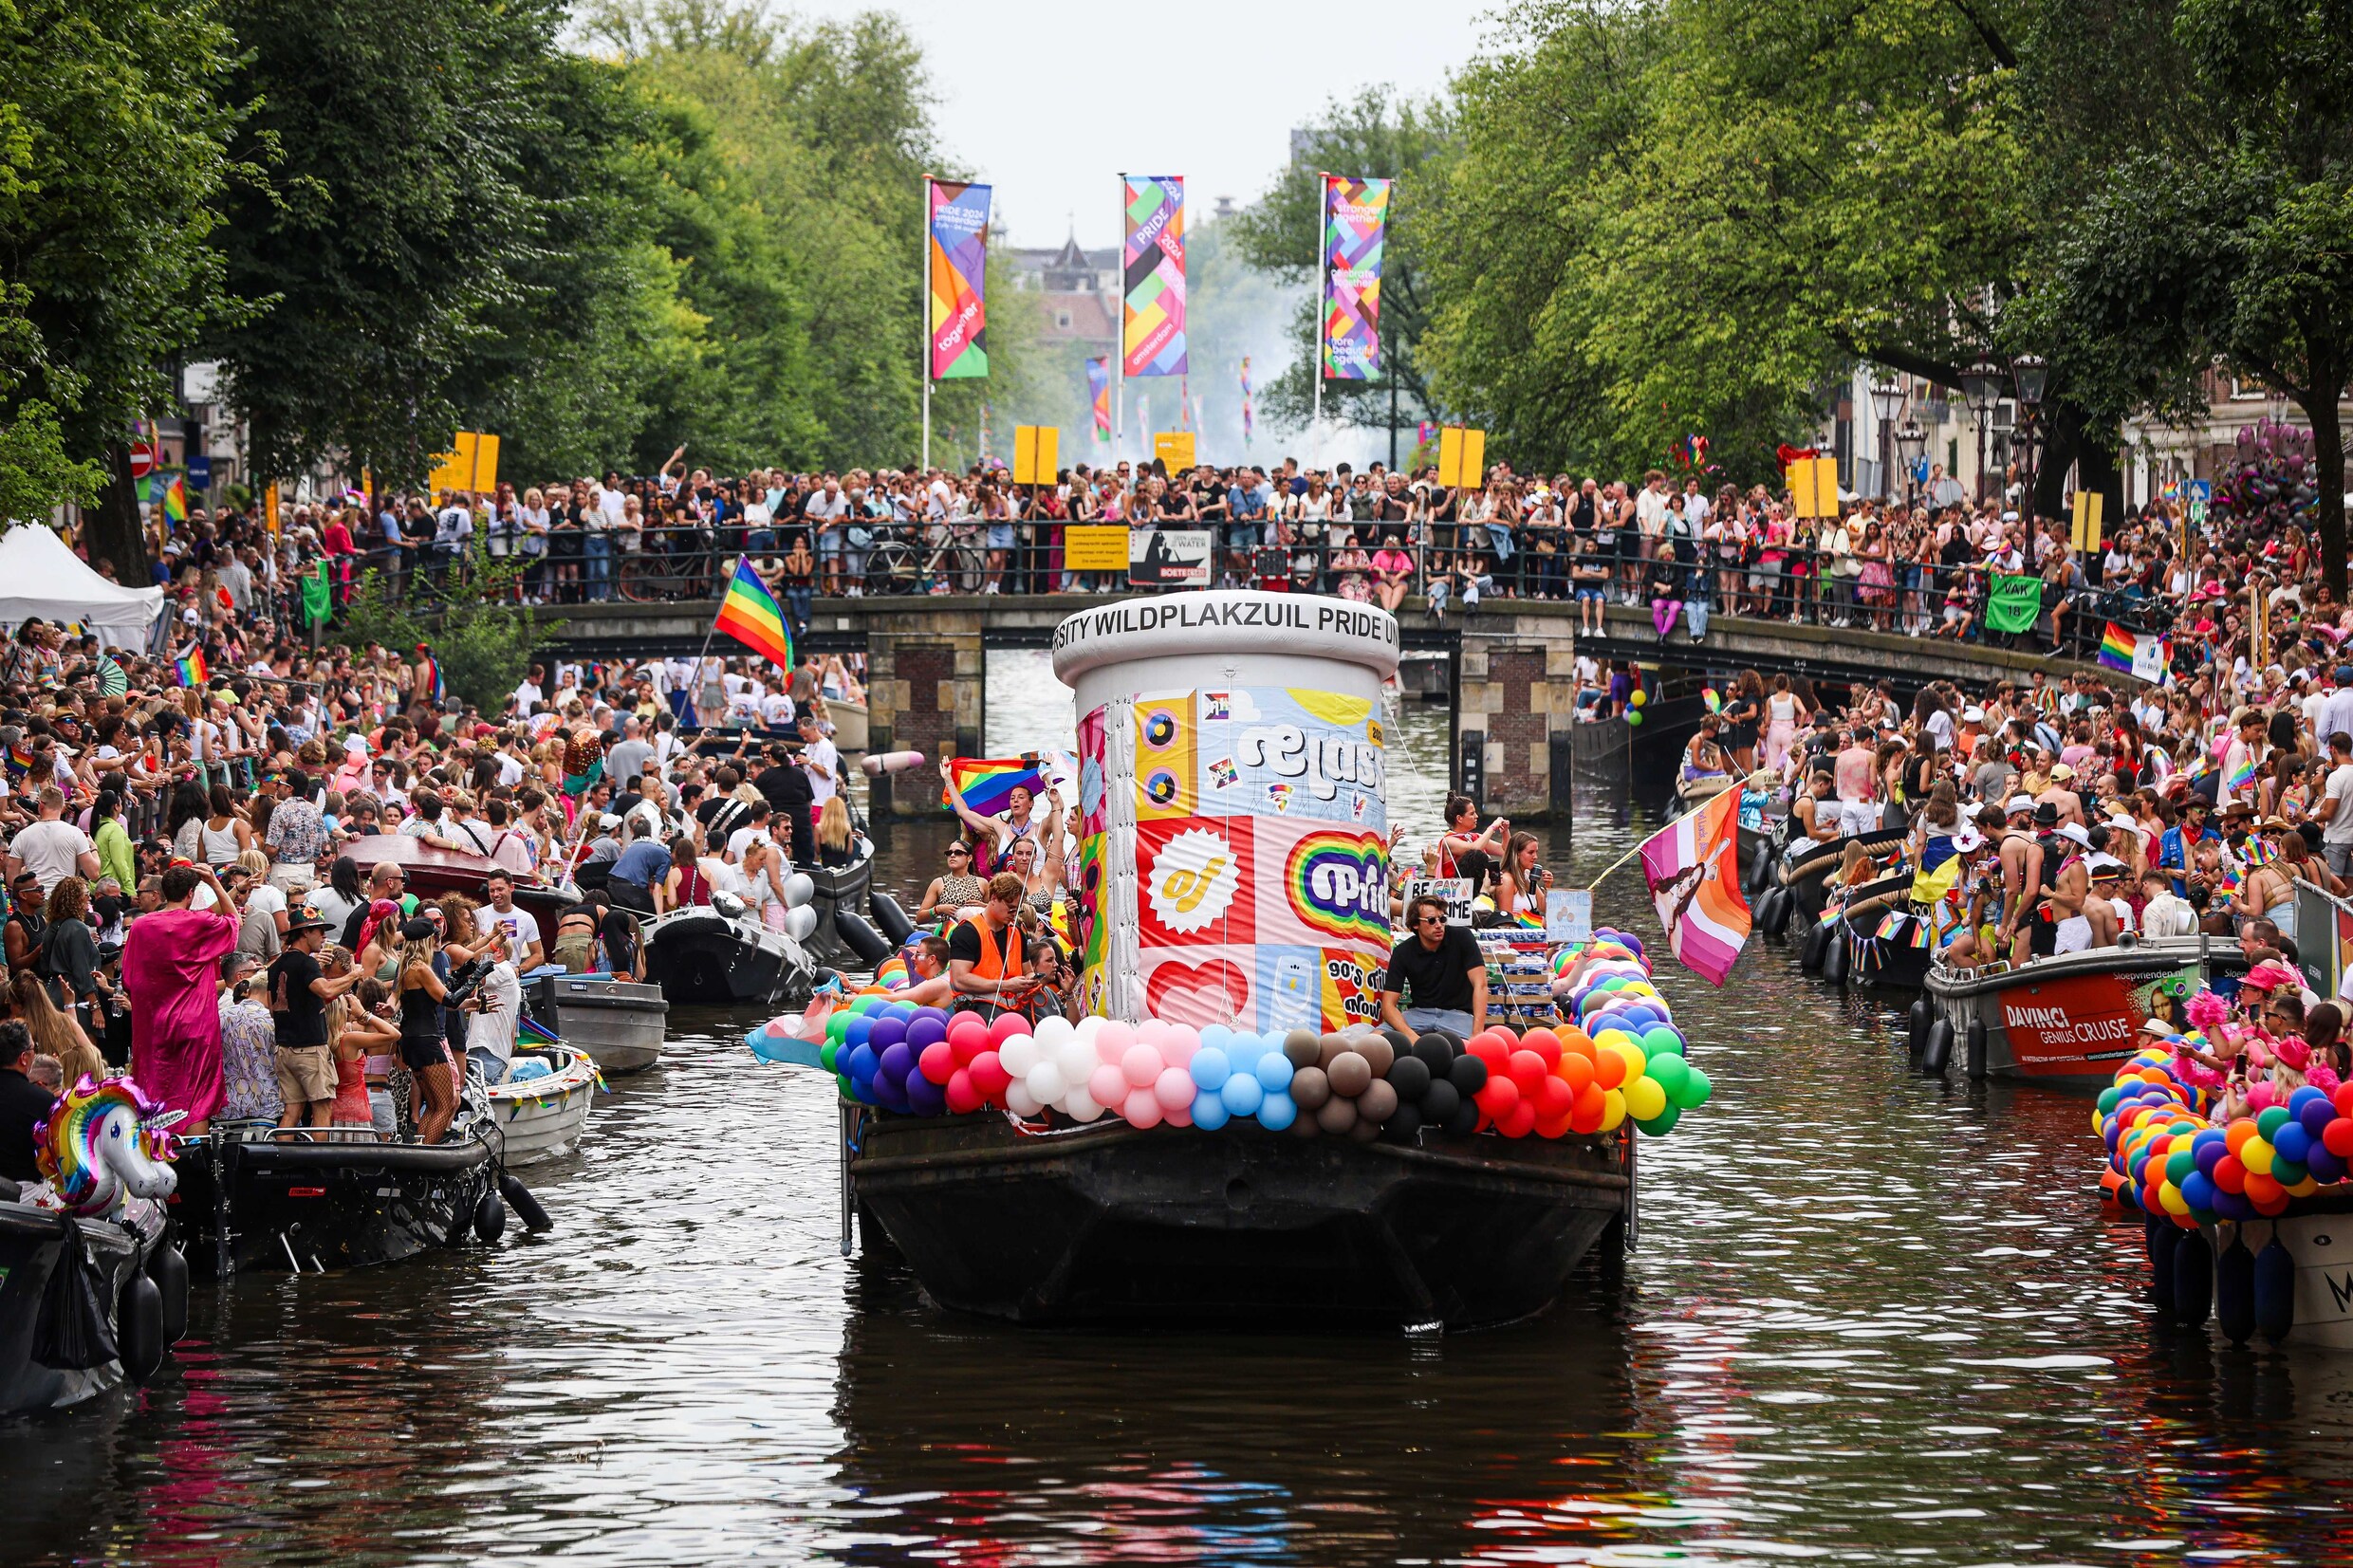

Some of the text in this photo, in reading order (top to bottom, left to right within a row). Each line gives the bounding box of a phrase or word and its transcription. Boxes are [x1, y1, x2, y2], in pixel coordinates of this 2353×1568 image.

[935, 204, 985, 218] PRIDE 2024
[1333, 212, 1378, 224] together
[1337, 203, 1381, 216] stronger
[1137, 208, 1170, 245] PRIDE
[1161, 233, 1182, 261] 2024
[1330, 267, 1377, 279] celebrate
[937, 302, 979, 352] together
[1133, 322, 1175, 366] amsterdam
[1332, 344, 1375, 356] beautiful
[2004, 581, 2029, 597] VAK
[2008, 604, 2021, 618] 18
[1095, 601, 1310, 636] WILDPLAKZUIL
[1318, 606, 1381, 641] PRIDE
[1161, 856, 1227, 913] of
[1433, 879, 1461, 898] GAY
[2113, 968, 2184, 981] Sloepvrienden.nl
[2005, 1005, 2070, 1028] DAVINCI
[2040, 1018, 2132, 1044] GENIUS CRUISE
